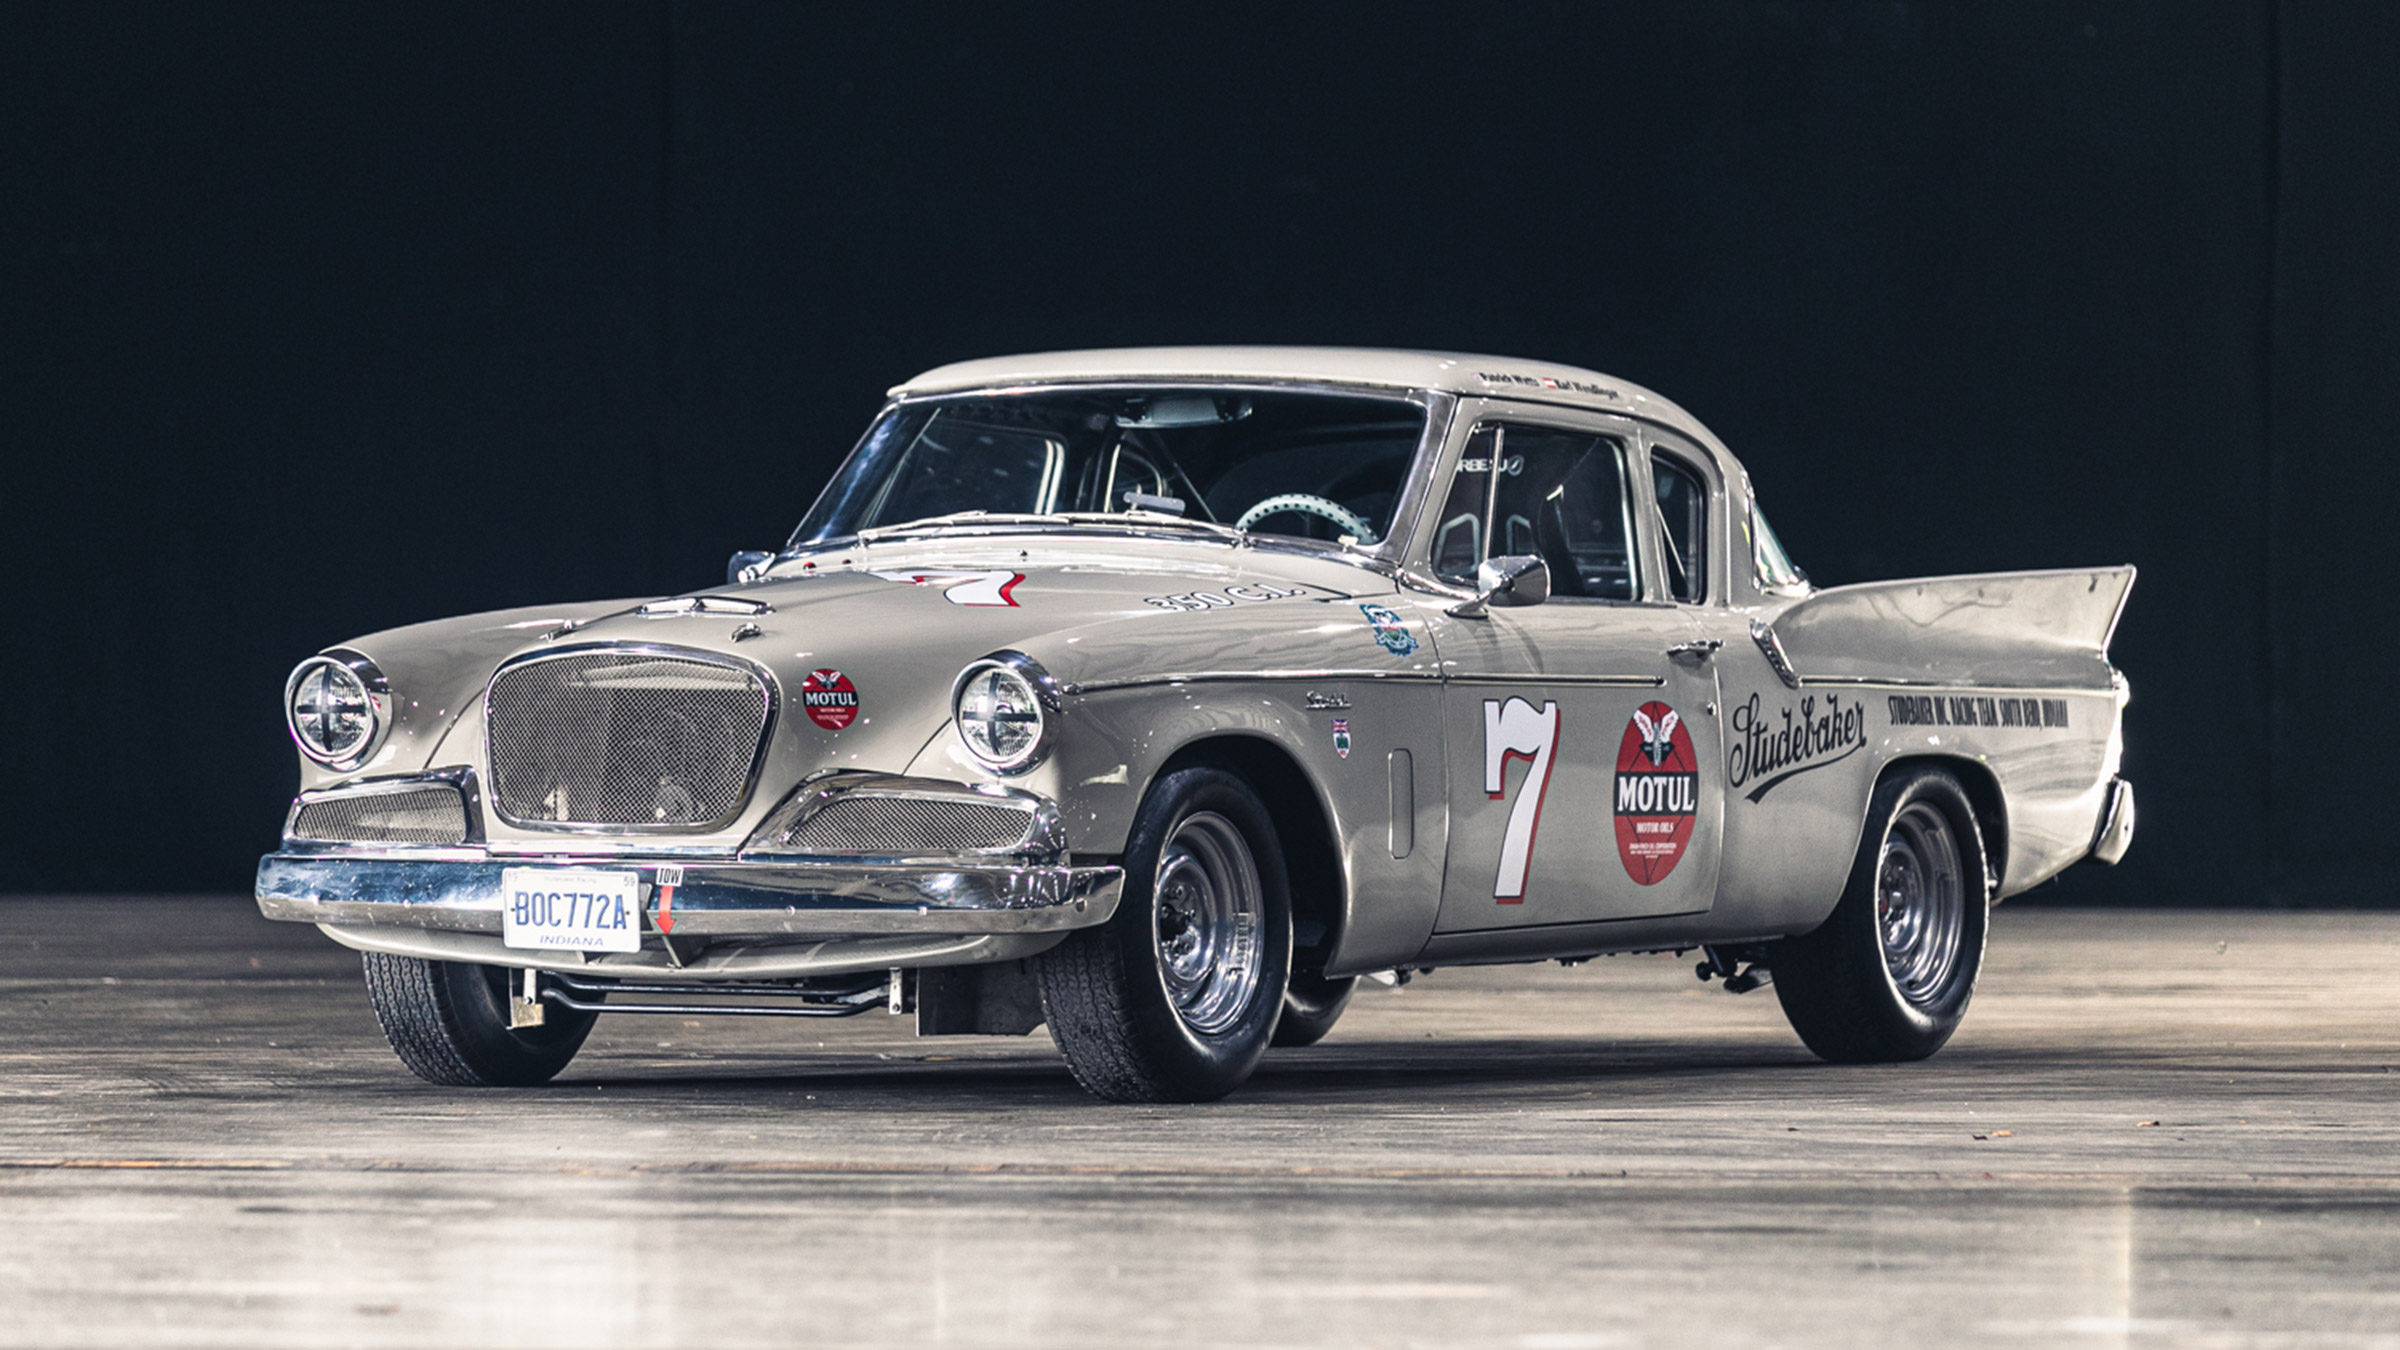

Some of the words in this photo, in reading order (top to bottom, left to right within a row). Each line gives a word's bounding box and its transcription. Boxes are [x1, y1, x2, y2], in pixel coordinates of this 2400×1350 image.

[1143, 591, 1234, 611] 350
[805, 692, 857, 706] MOTUL
[1729, 691, 1868, 790] Studebaker
[1483, 695, 1562, 905] 7
[1617, 775, 1695, 812] MOTUL
[1636, 822, 1659, 834] MOTOR
[1660, 822, 1674, 834] OILS
[623, 877, 636, 888] 59
[659, 868, 682, 885] TOW
[540, 935, 604, 947] INDIANA
